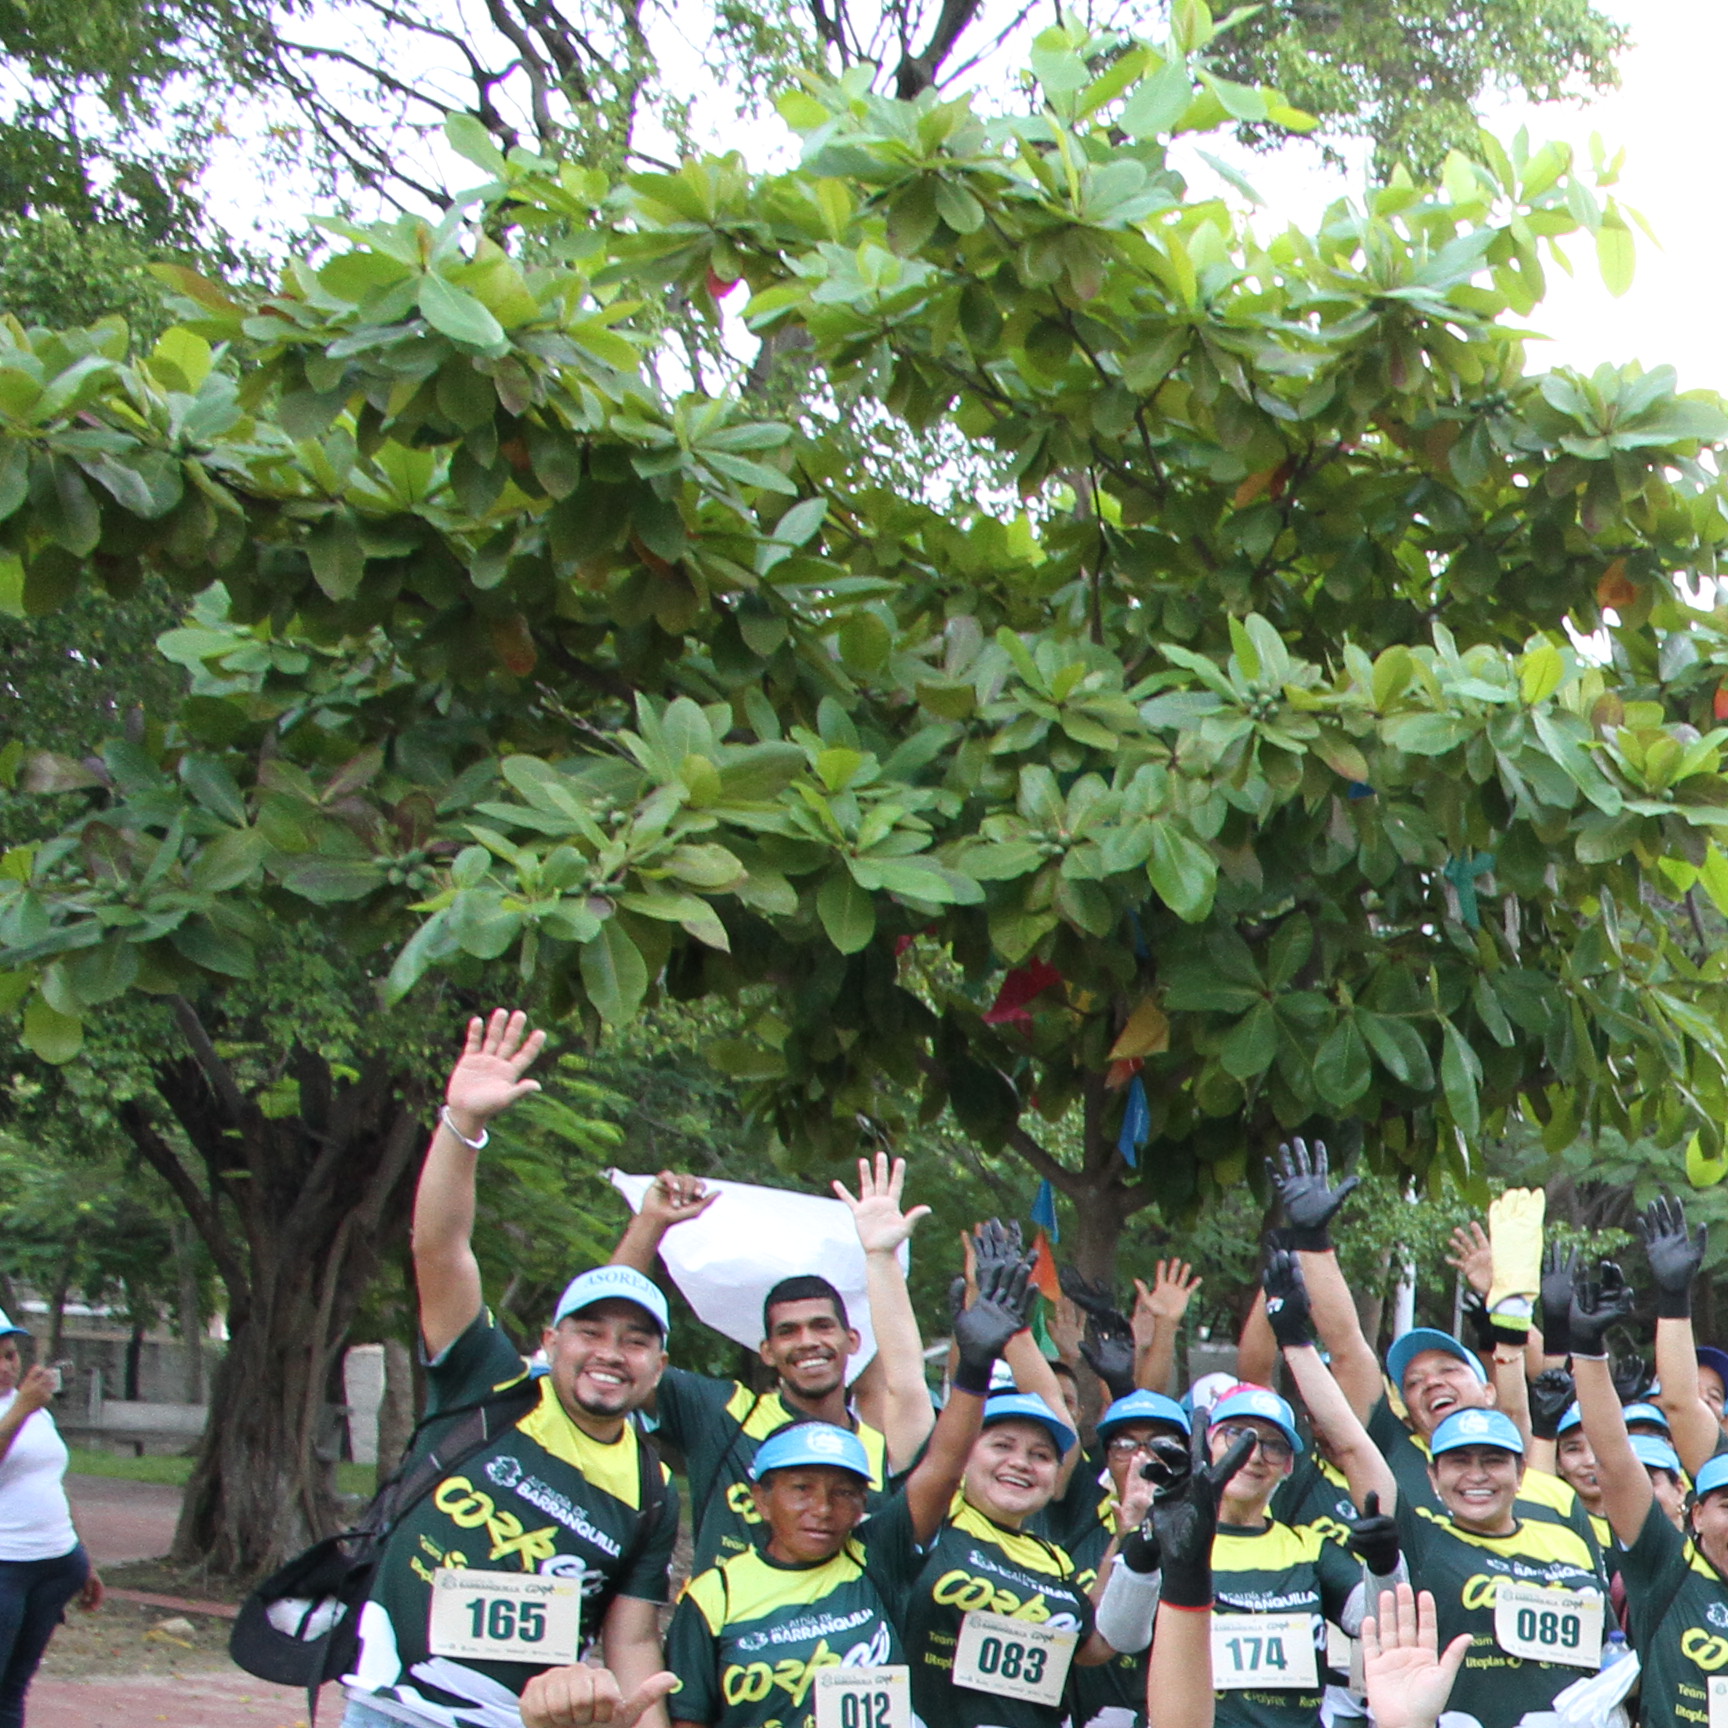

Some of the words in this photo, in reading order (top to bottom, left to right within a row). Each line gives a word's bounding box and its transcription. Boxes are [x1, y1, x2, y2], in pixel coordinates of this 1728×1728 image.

[573, 1502, 589, 1521] DE
[466, 1598, 548, 1643] 165
[1517, 1608, 1581, 1648] 089
[1225, 1636, 1289, 1671] 174
[1471, 1636, 1494, 1647] eam
[978, 1636, 1048, 1684] 083
[1675, 1704, 1709, 1724] litopla
